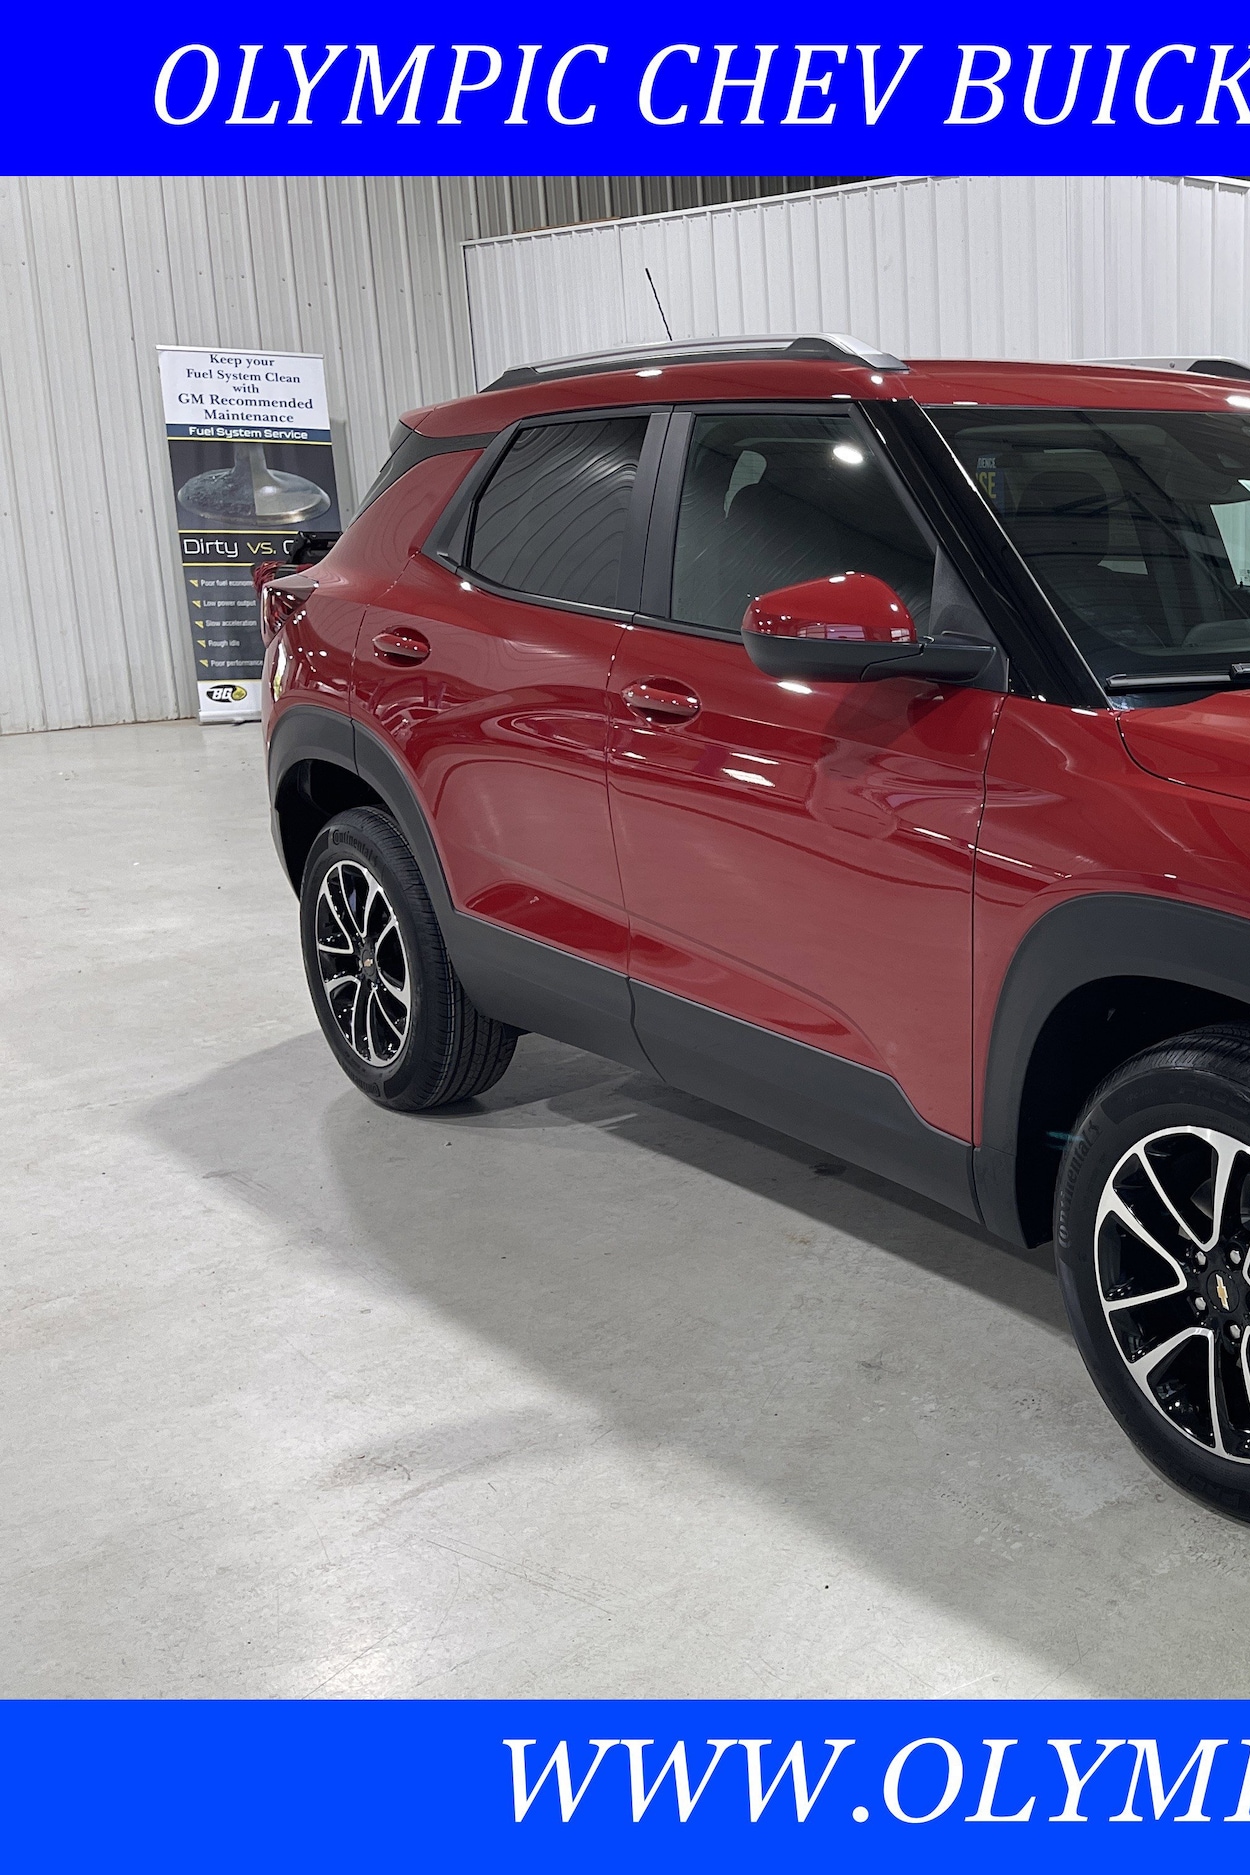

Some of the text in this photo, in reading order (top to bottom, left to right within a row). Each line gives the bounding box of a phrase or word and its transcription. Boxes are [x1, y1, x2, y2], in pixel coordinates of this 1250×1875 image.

[209, 354, 275, 368] Keep your
[186, 368, 301, 383] Fuel System Clean
[232, 383, 259, 393] with
[178, 393, 313, 410] GM Recommended
[204, 409, 294, 423] Maintenance
[188, 426, 308, 440] Fuel System Service
[183, 538, 239, 558] Dirty
[246, 542, 277, 555] vs.
[201, 579, 215, 587] Poor
[216, 579, 228, 587] fuel
[217, 600, 236, 608] power
[236, 600, 257, 608] output
[205, 619, 220, 627] Slow
[208, 640, 228, 648] Rough
[212, 687, 234, 700] BG
